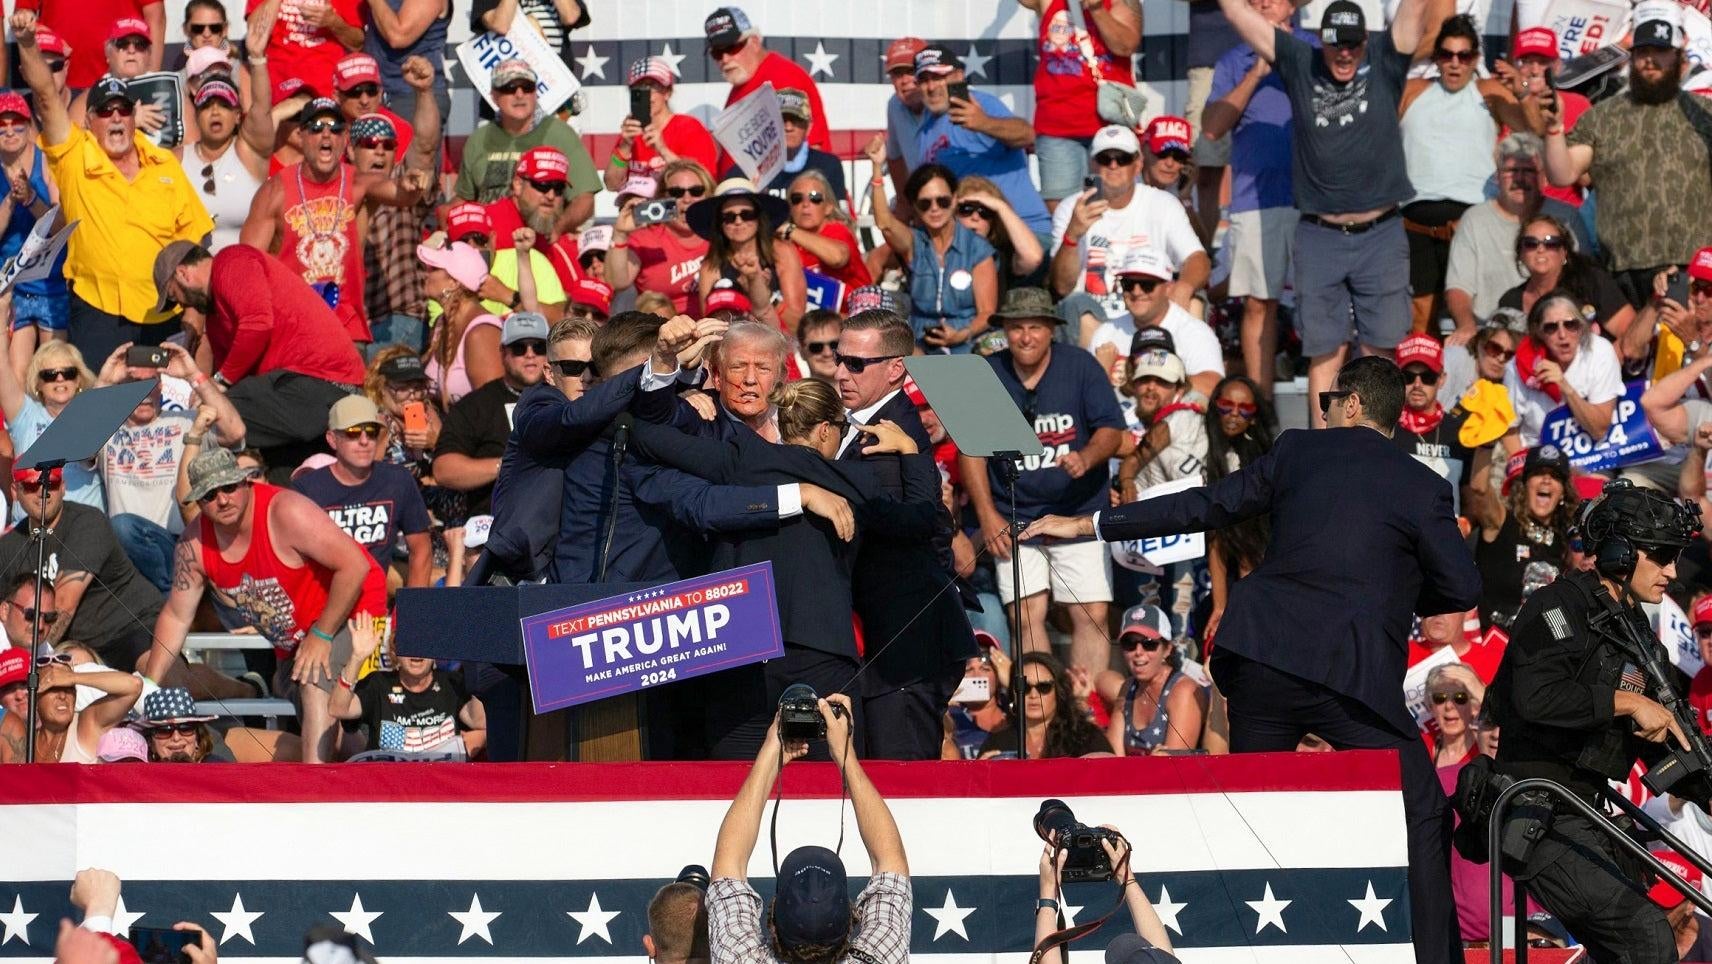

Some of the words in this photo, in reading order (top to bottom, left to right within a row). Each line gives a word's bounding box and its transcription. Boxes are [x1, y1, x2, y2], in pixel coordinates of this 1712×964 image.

[1560, 15, 1588, 61] U'RE
[1549, 400, 1637, 441] TRP
[552, 618, 585, 636] TEXT
[587, 596, 683, 629] PENNSYLVANIA
[685, 592, 702, 605] TO
[704, 581, 744, 600] 88022
[571, 603, 731, 669] TRUMP
[585, 667, 613, 683] MAKE
[615, 659, 658, 678] AMERICA
[660, 651, 691, 665] GREAT
[693, 642, 728, 658] AGAIN!
[640, 667, 677, 688] 2024
[1620, 680, 1645, 695] POLICE
[397, 715, 413, 726] AM
[417, 711, 447, 726] MORE
